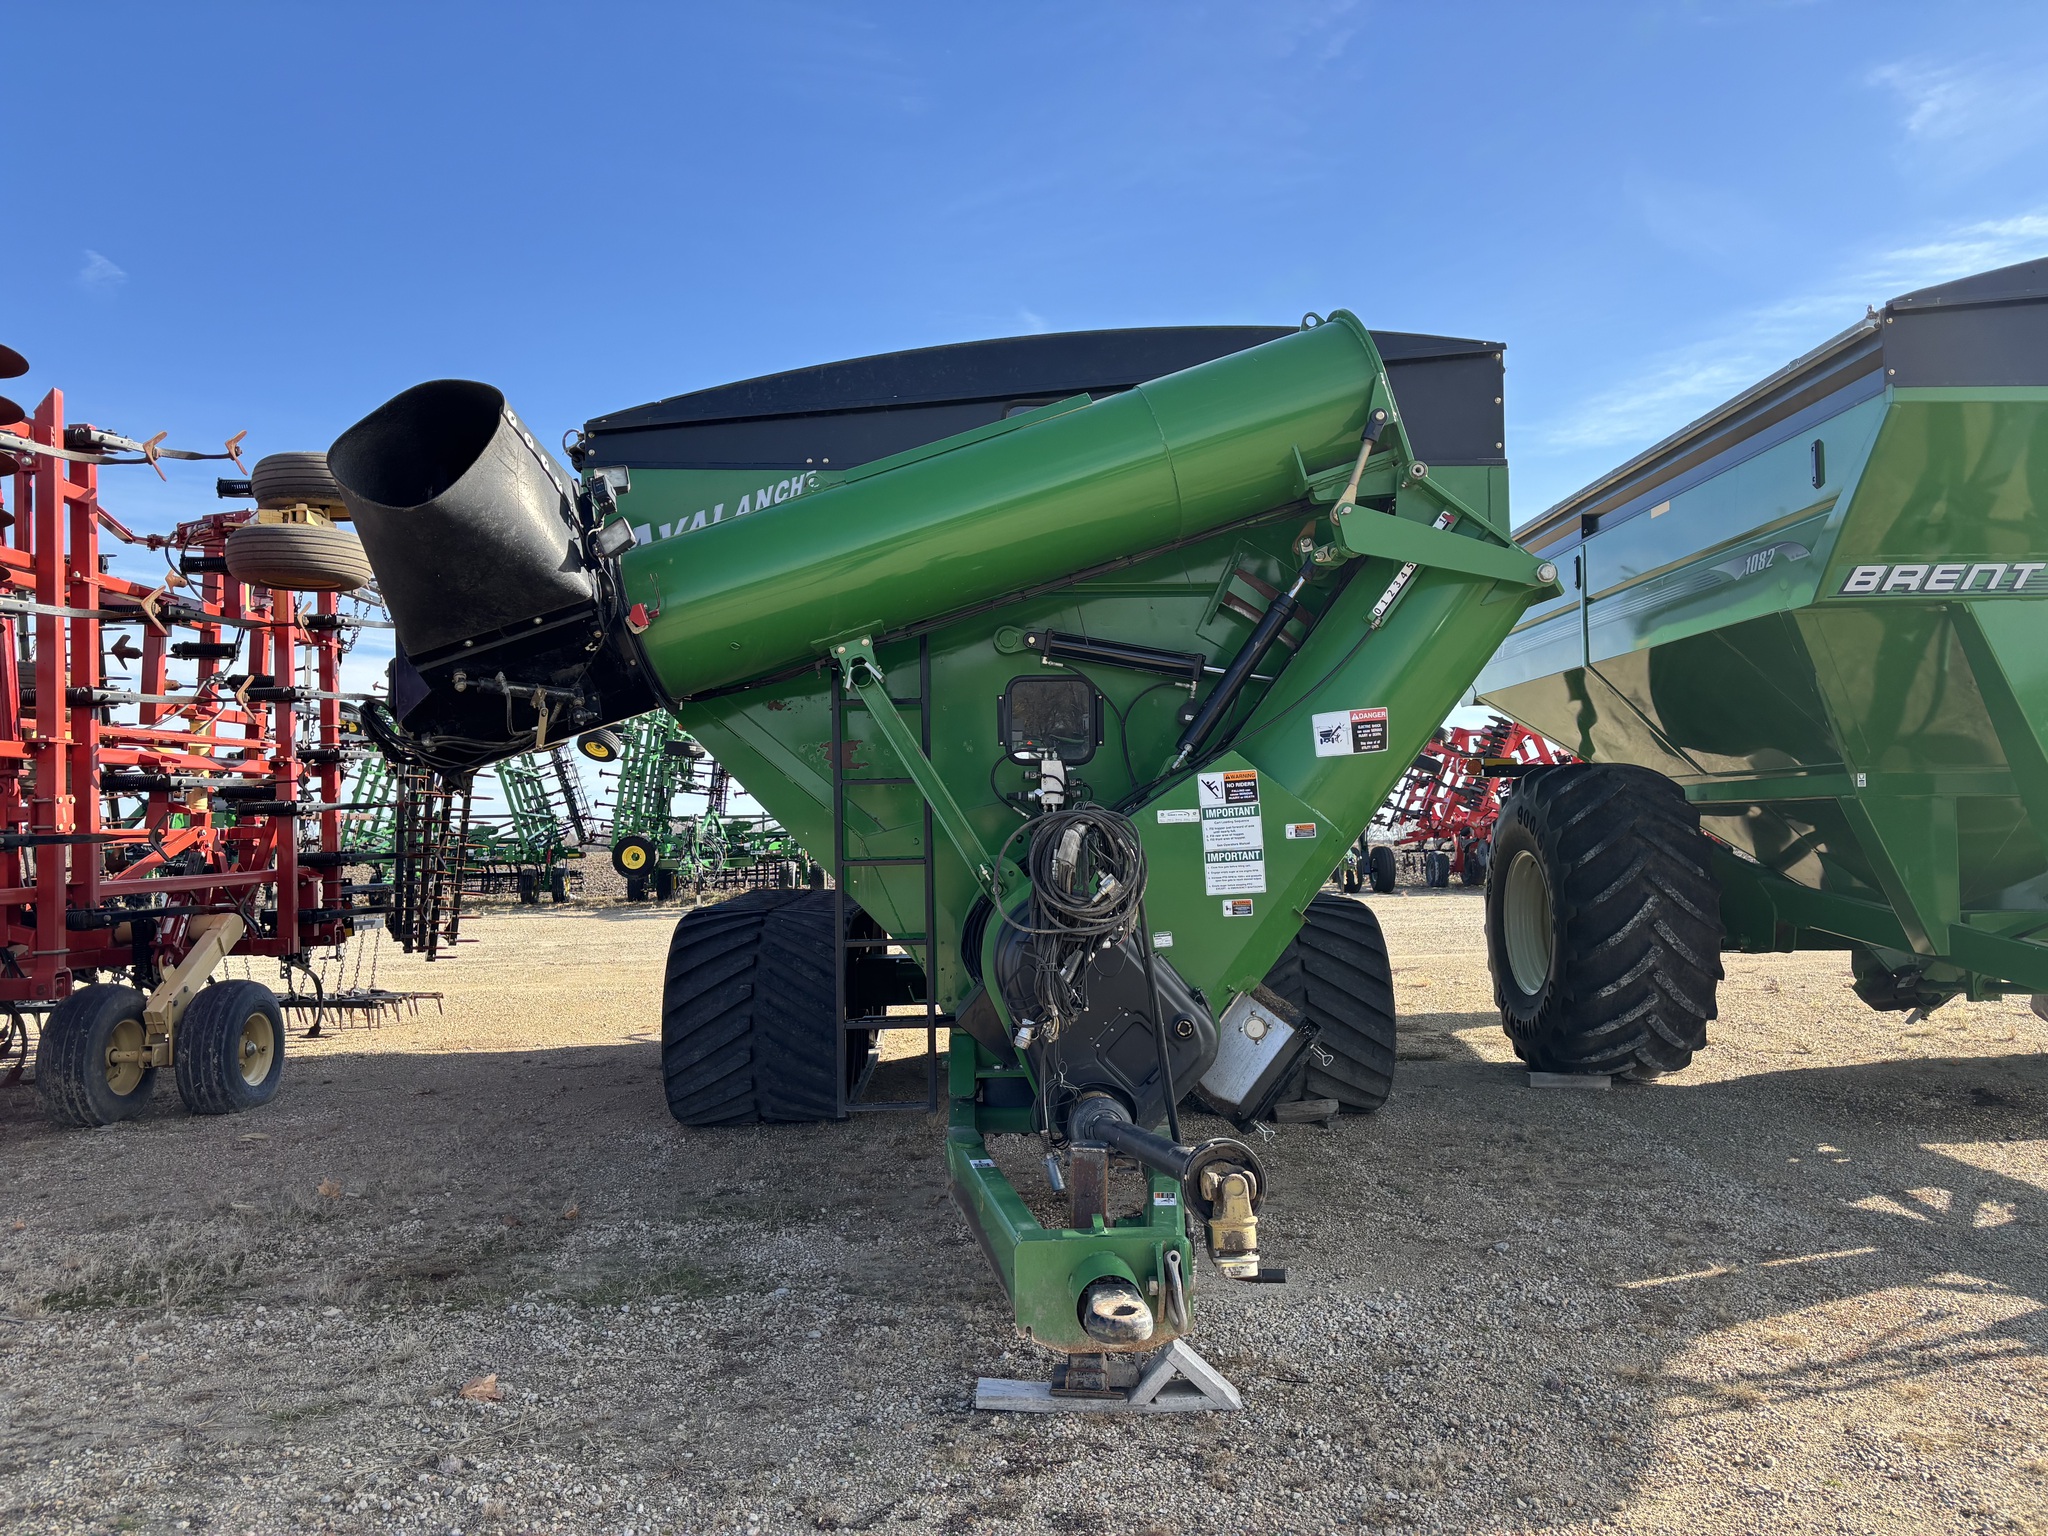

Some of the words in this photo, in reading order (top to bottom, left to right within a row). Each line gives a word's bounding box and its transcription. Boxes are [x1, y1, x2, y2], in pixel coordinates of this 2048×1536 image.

[1746, 548, 1775, 576] 1082
[1393, 580, 1401, 588] 3
[1406, 562, 1414, 570] 5
[1839, 563, 2047, 593] BRENT
[1358, 712, 1386, 720] DANGER
[1206, 806, 1256, 818] IMPORTANT
[1207, 850, 1260, 862] IMPORTANT
